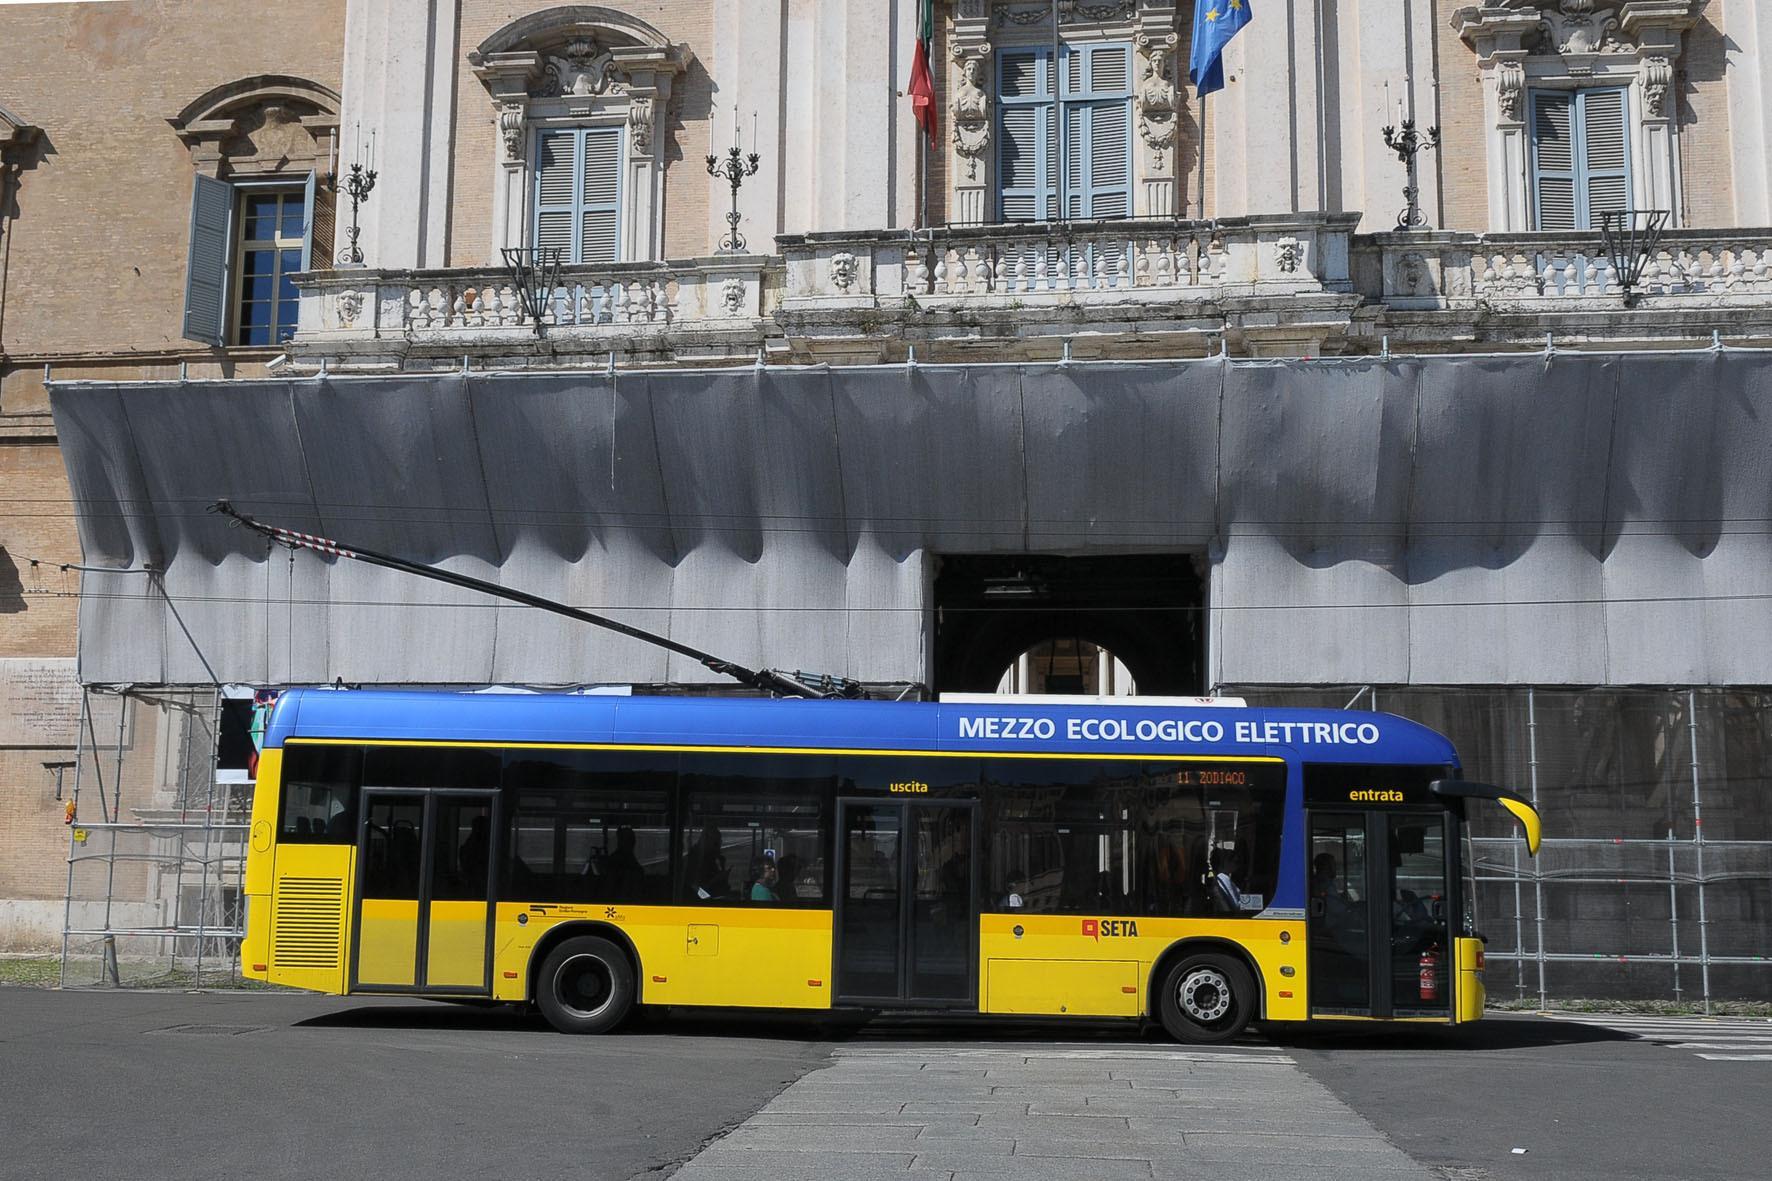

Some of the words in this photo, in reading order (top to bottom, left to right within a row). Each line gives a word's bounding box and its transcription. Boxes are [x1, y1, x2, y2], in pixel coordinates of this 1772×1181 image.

[958, 717, 1056, 740] MEZZO
[1067, 718, 1224, 742] ECOLOGICO
[1235, 720, 1380, 745] ELETTRICO
[1177, 771, 1190, 784] 11
[1199, 771, 1246, 785] ZODIACO
[889, 780, 929, 793] uscita
[1349, 788, 1405, 802] entrata
[1100, 919, 1138, 937] SETA
